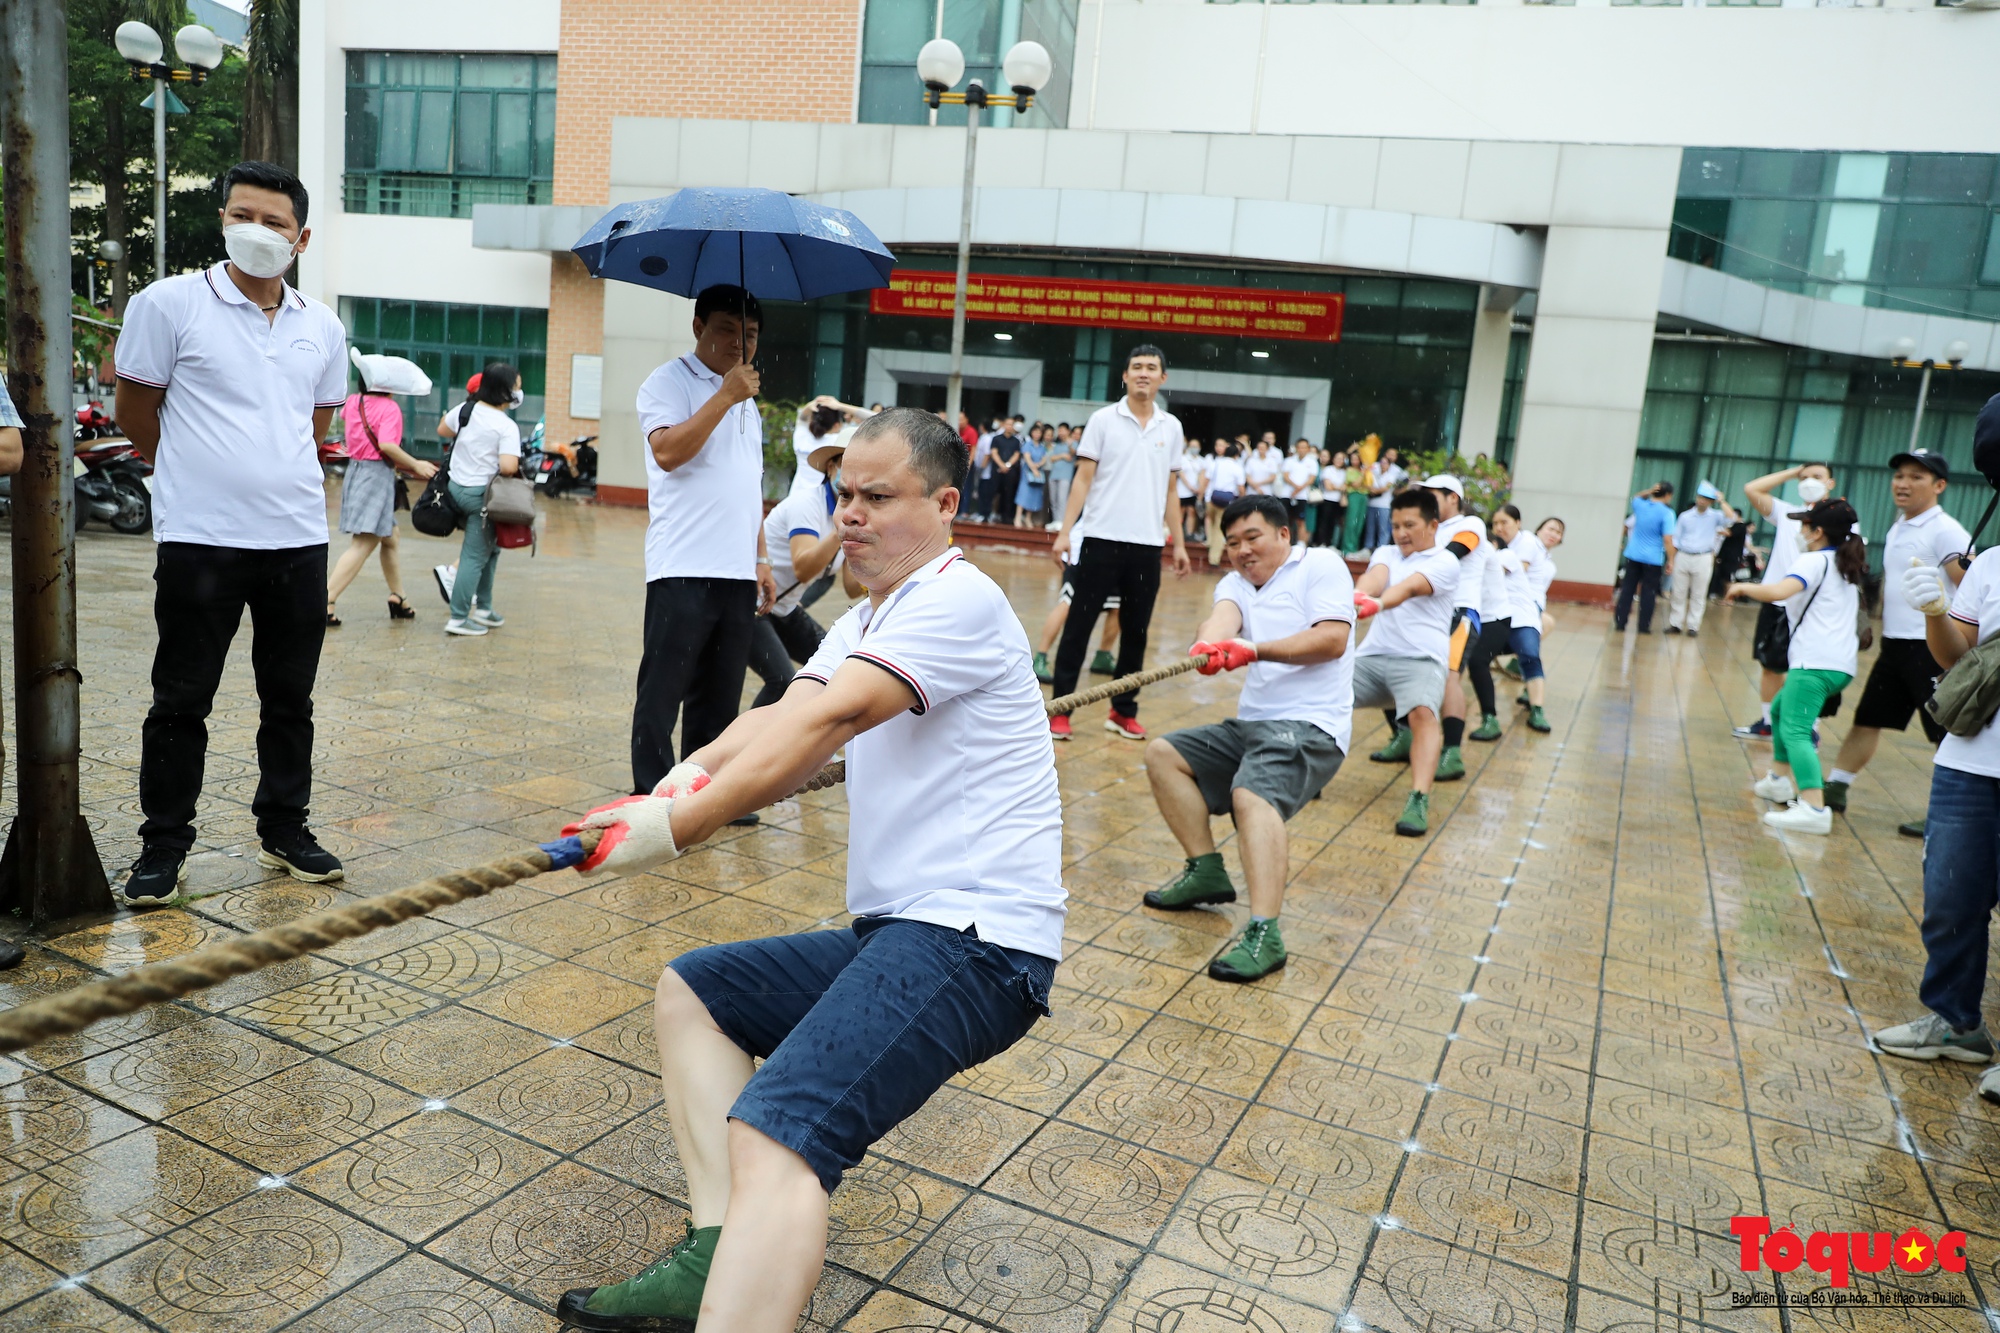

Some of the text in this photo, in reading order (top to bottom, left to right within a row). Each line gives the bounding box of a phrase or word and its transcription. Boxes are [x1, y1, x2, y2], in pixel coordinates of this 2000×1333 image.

[914, 280, 932, 295] LIỆT
[965, 284, 984, 296] ỪNG
[986, 286, 998, 297] 77
[998, 285, 1021, 298] NĂM
[1021, 287, 1046, 299] NGÀY
[1047, 288, 1072, 300] CÁCH
[1073, 290, 1101, 303] MẠNG
[1102, 291, 1133, 304] THÁNG
[1134, 293, 1155, 306] TÁM
[1156, 294, 1187, 308] THÀNH
[1188, 296, 1215, 309] CÔNG
[902, 295, 914, 308] VÀ
[915, 297, 939, 309] NGÀY
[996, 302, 1020, 314] NƯỚC
[1022, 304, 1047, 317] CỘNG
[1069, 305, 1082, 317] XÃ
[1083, 306, 1099, 321] HỘI
[1100, 307, 1120, 320] CHỦ
[1121, 308, 1150, 322] NGHĨA
[1151, 309, 1171, 325] VIỆT
[1172, 313, 1195, 325] NAM
